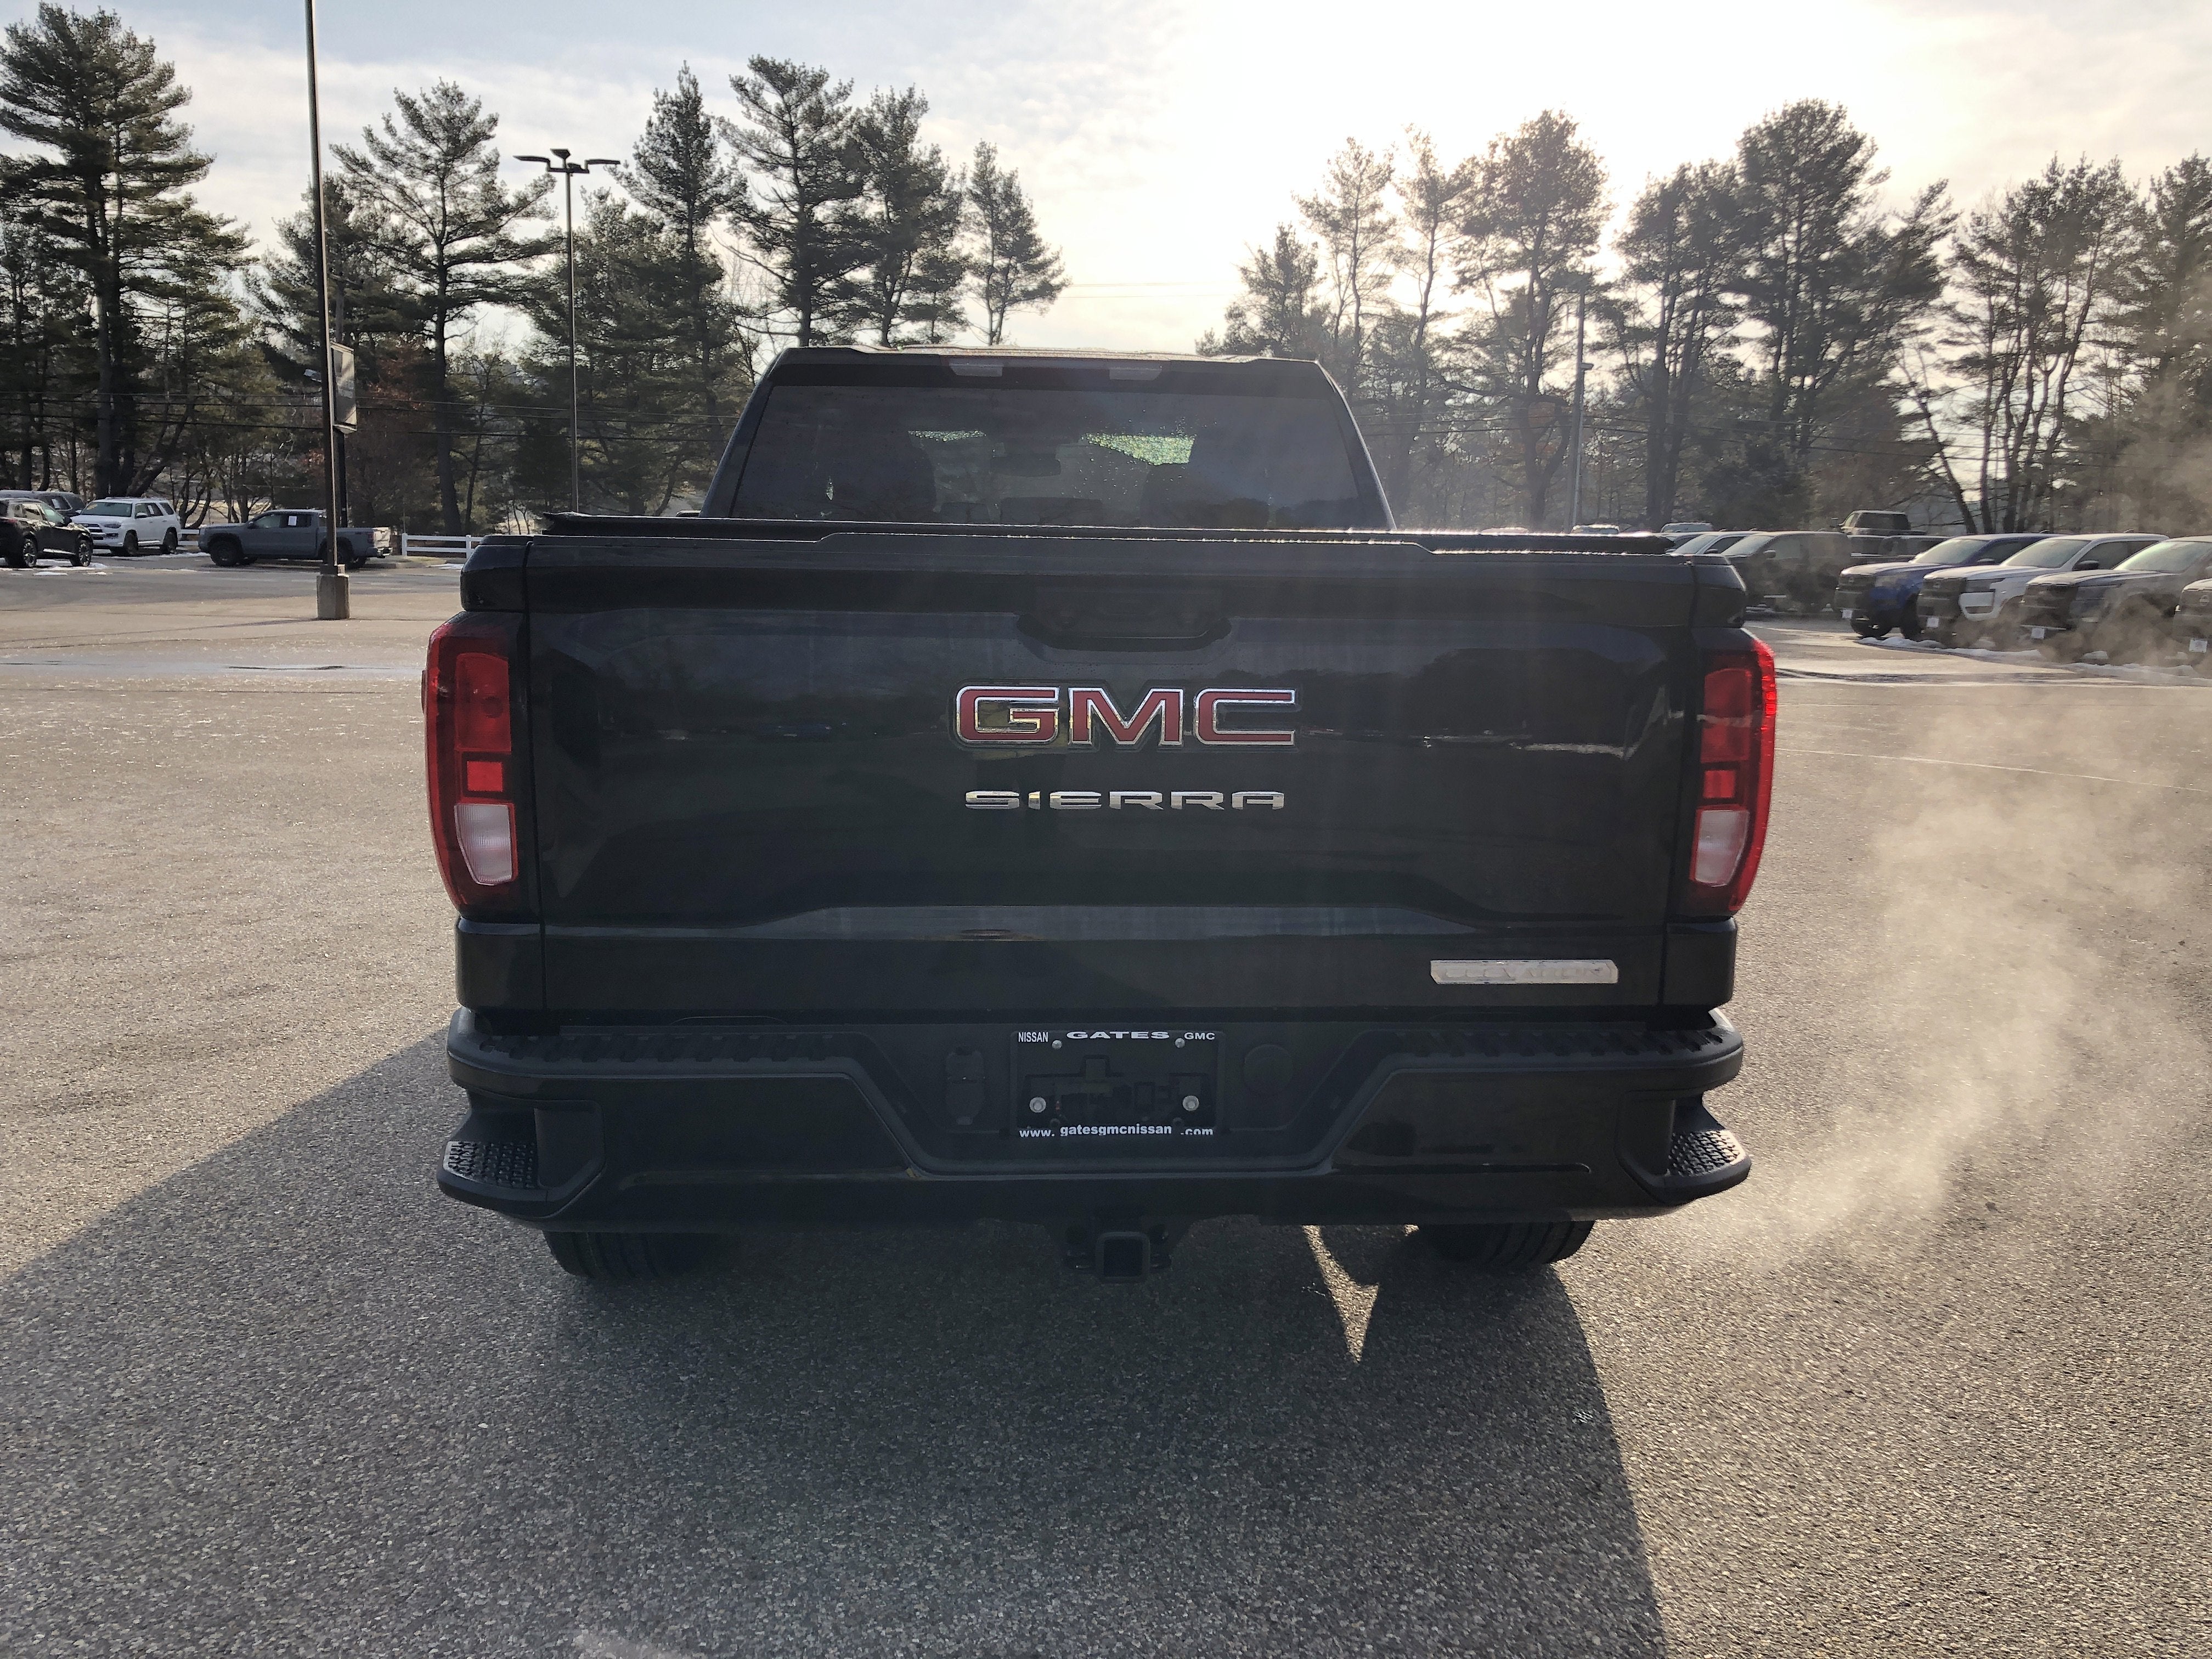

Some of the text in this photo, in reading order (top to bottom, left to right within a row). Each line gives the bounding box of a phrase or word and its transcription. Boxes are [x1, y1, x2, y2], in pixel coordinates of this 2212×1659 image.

[956, 686, 1295, 745] GMC
[965, 791, 1284, 810] SIERRA
[1018, 1031, 1215, 1042] NISSAN GATES GMC
[1060, 1124, 1172, 1137] gatesgmcnissan
